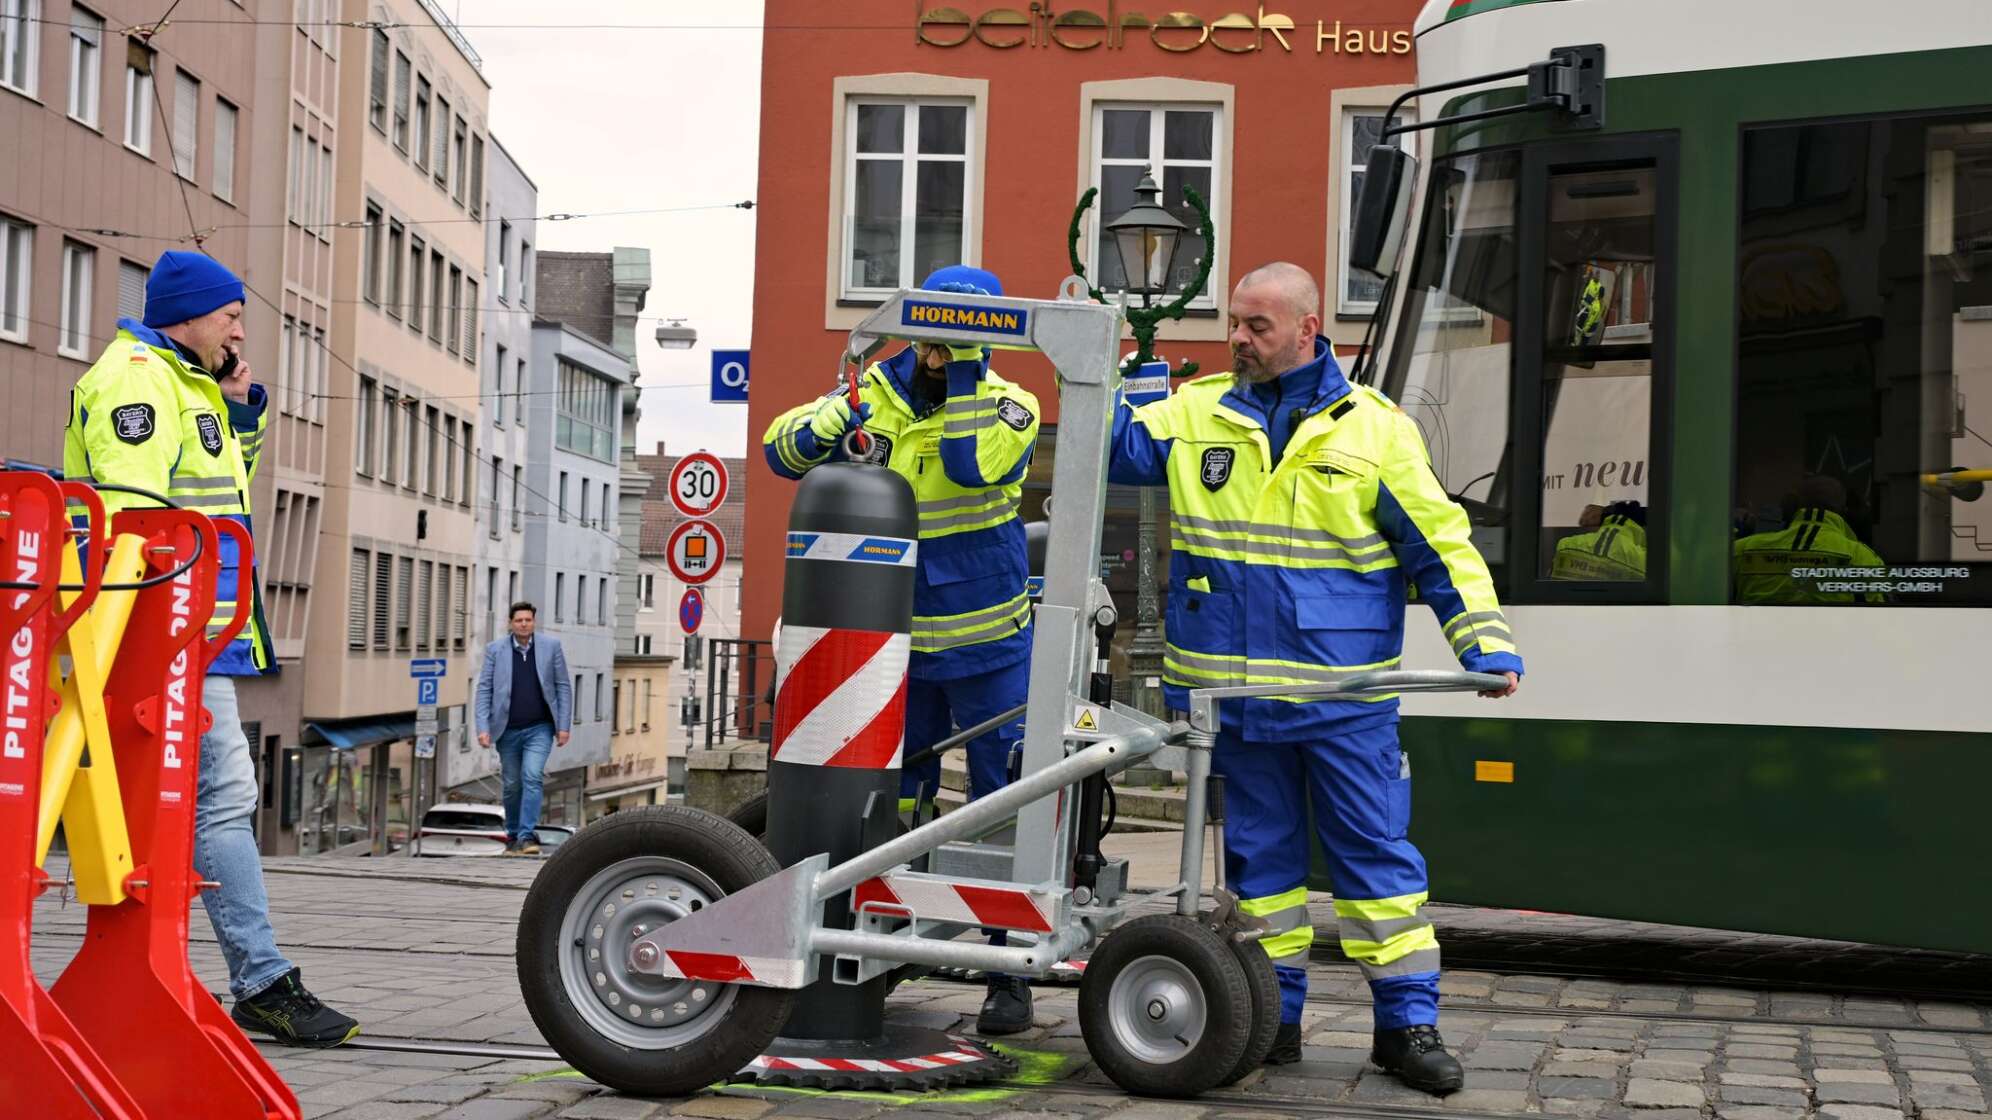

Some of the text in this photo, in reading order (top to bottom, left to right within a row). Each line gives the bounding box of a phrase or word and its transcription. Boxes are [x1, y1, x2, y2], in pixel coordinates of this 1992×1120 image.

[1316, 20, 1411, 54] Haus
[911, 305, 1018, 329] HÖRMANN
[1124, 379, 1164, 391] Einbahnstraße
[682, 470, 714, 498] 30
[1573, 460, 1644, 489] neu
[1791, 567, 1970, 578] STADTWERKE AUGSBURG
[1816, 582, 1943, 592] VERKEHRS-GMBH
[422, 681, 434, 702] P
